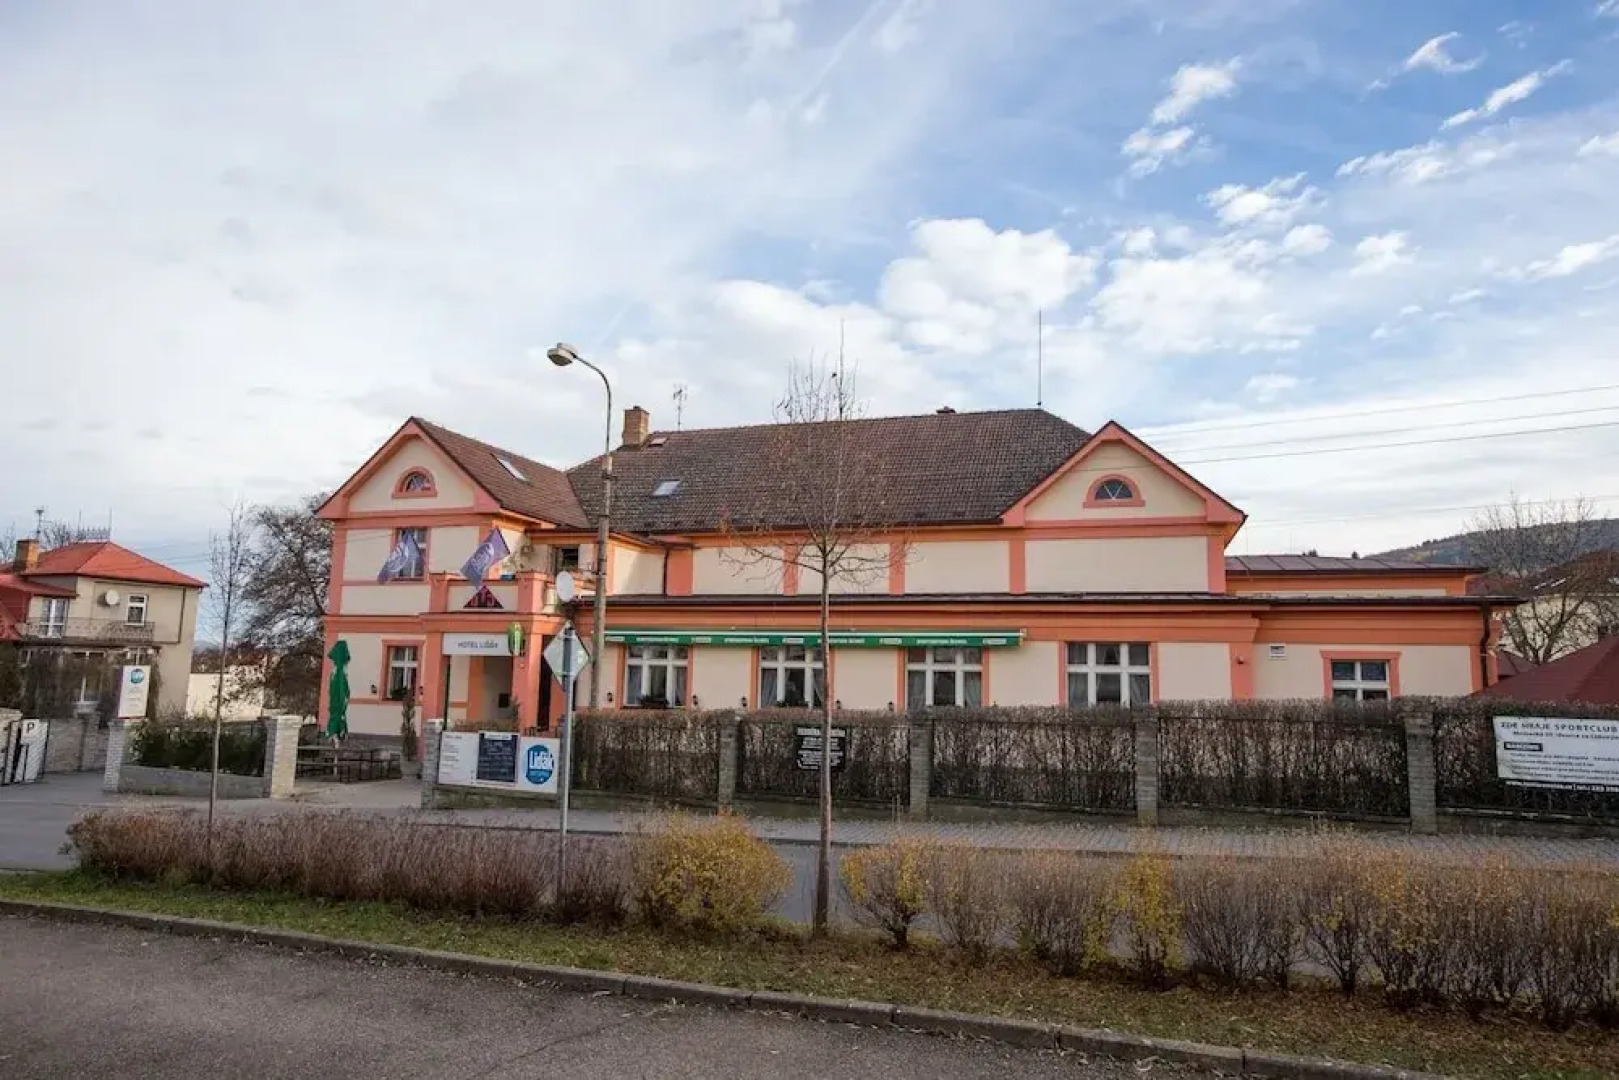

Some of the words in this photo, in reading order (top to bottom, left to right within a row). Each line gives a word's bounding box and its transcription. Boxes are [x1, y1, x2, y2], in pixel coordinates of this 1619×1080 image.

[458, 641, 478, 649] HOTEL
[27, 722, 35, 733] P
[1554, 723, 1618, 733] SPORTCLUB
